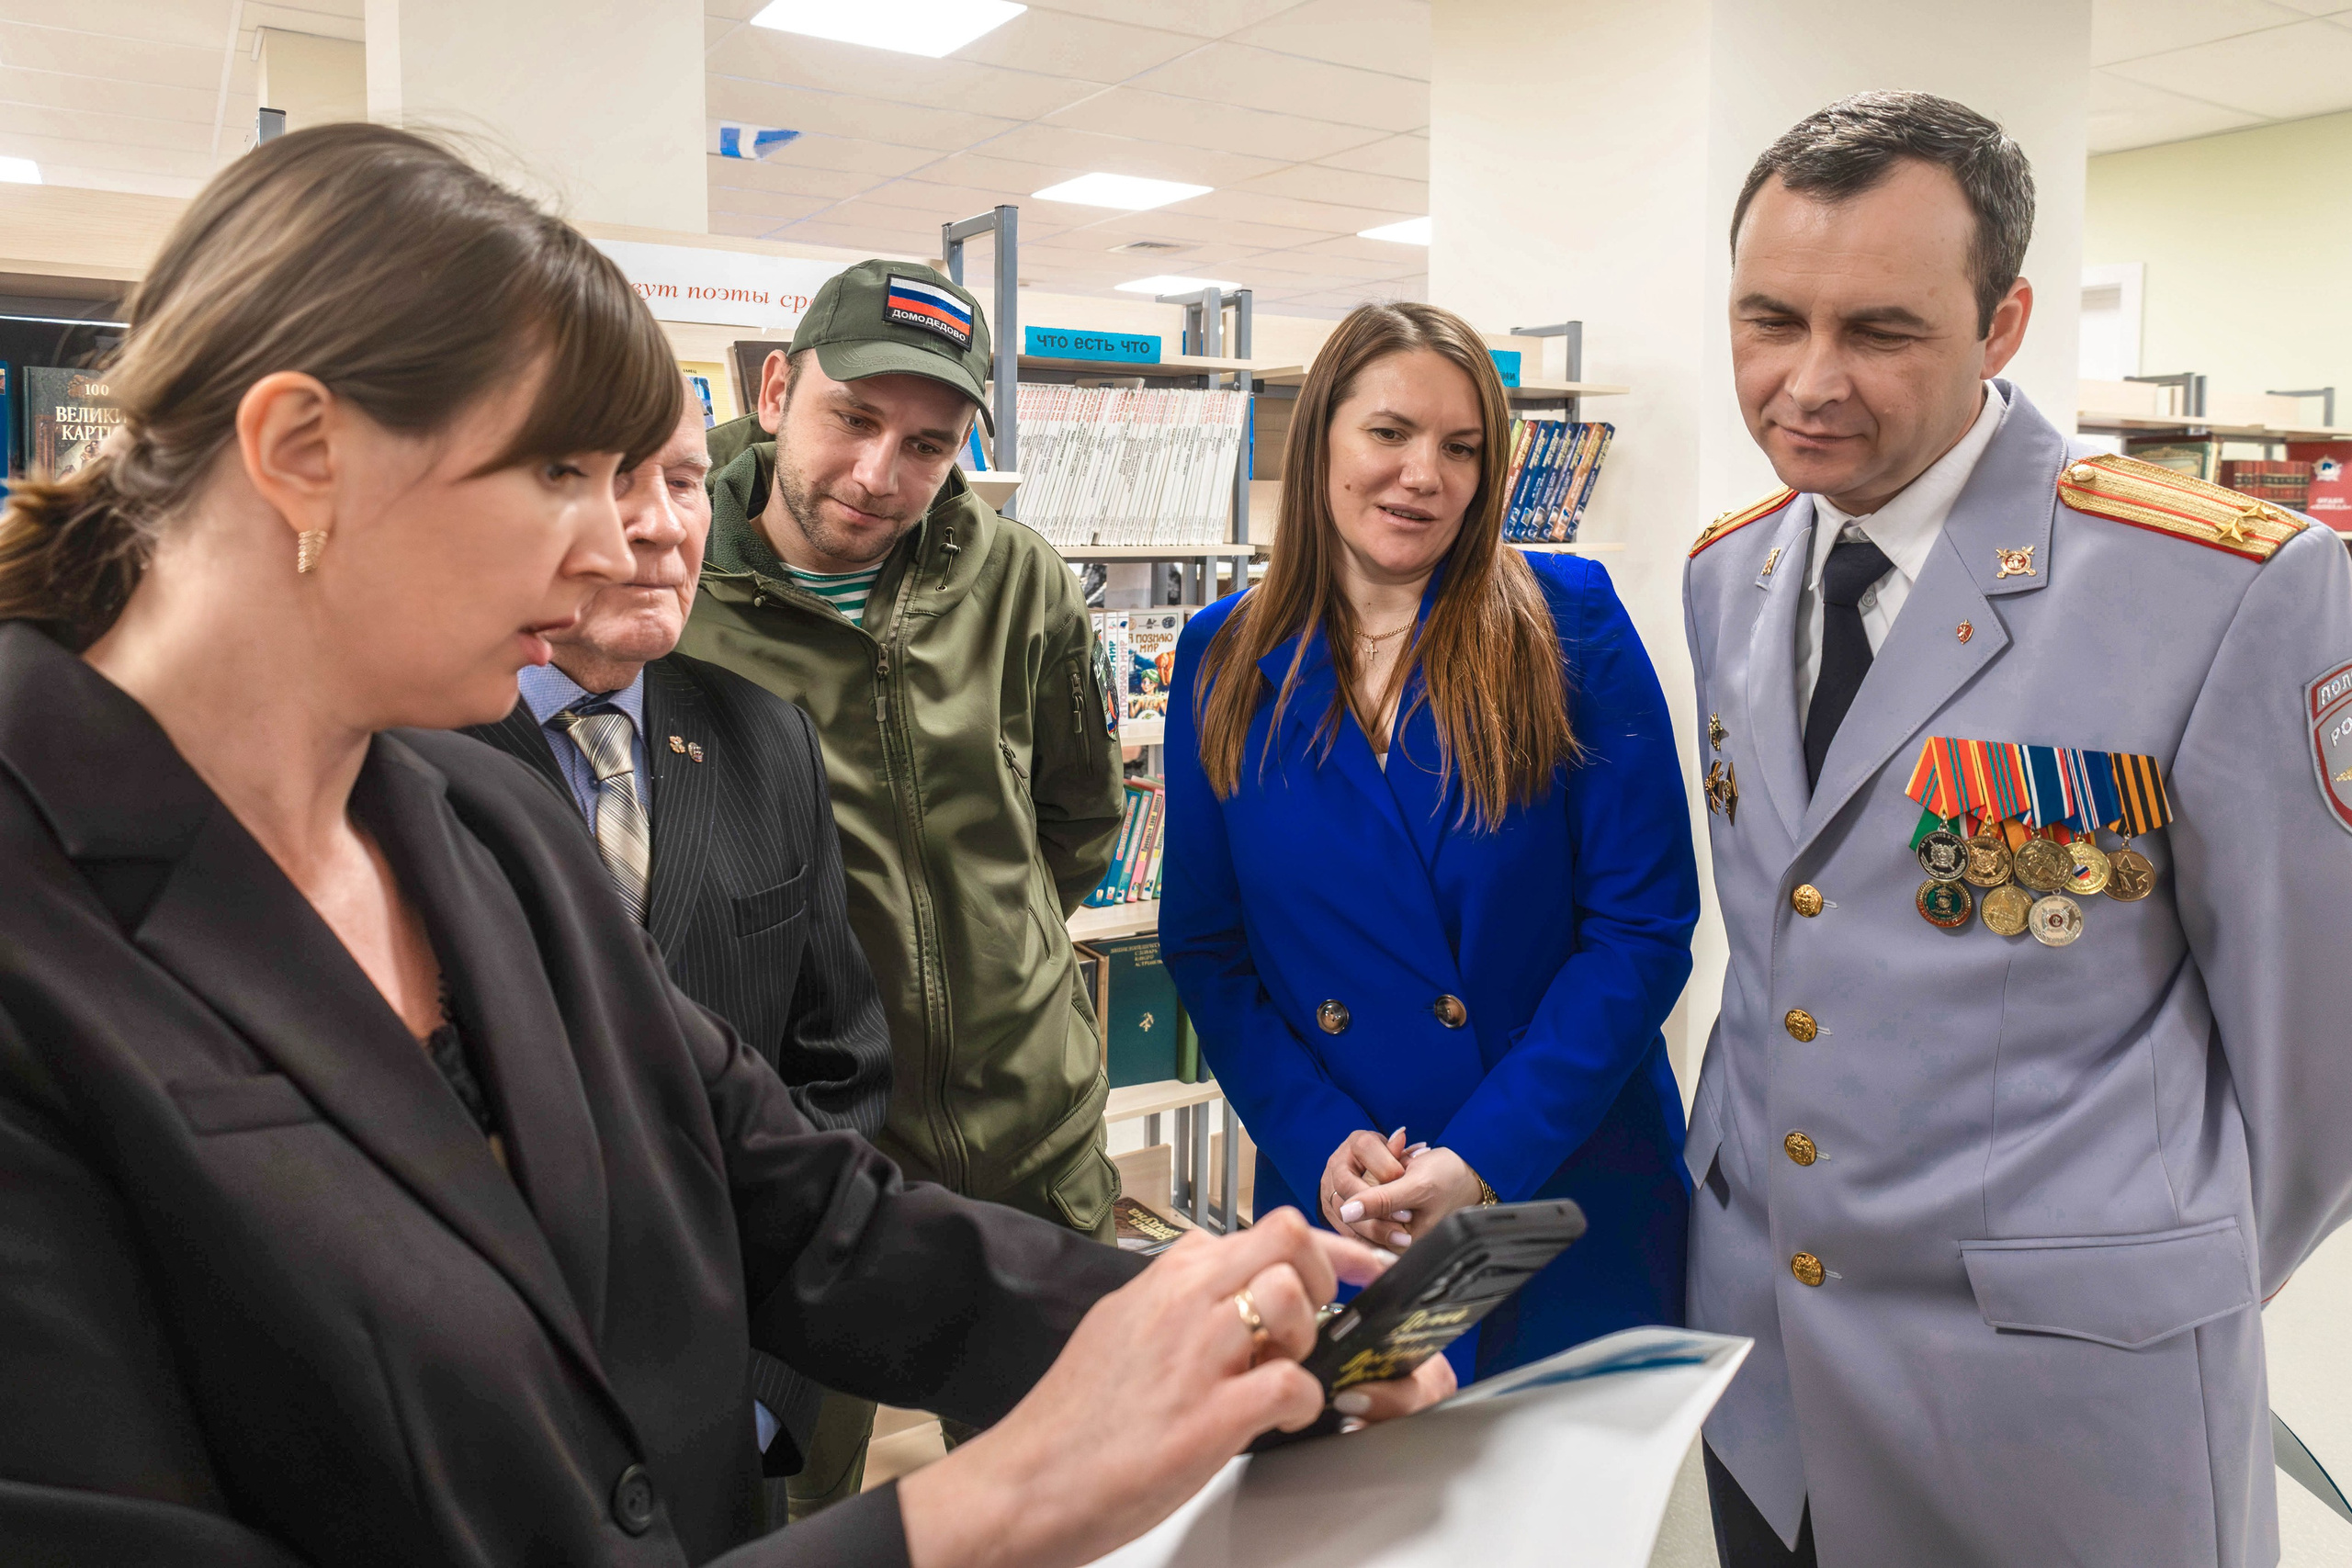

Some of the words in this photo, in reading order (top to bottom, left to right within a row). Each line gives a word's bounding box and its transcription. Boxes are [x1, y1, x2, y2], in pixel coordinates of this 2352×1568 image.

[687, 286, 770, 305] поэты
[779, 293, 815, 313] ср
[891, 308, 967, 343] ДОМОДЕДОВО
[85, 384, 109, 396] 100
[1136, 633, 1173, 644] ПОЗНАЮ
[1139, 643, 1159, 653] МИР
[2320, 671, 2352, 705] ПОЛ
